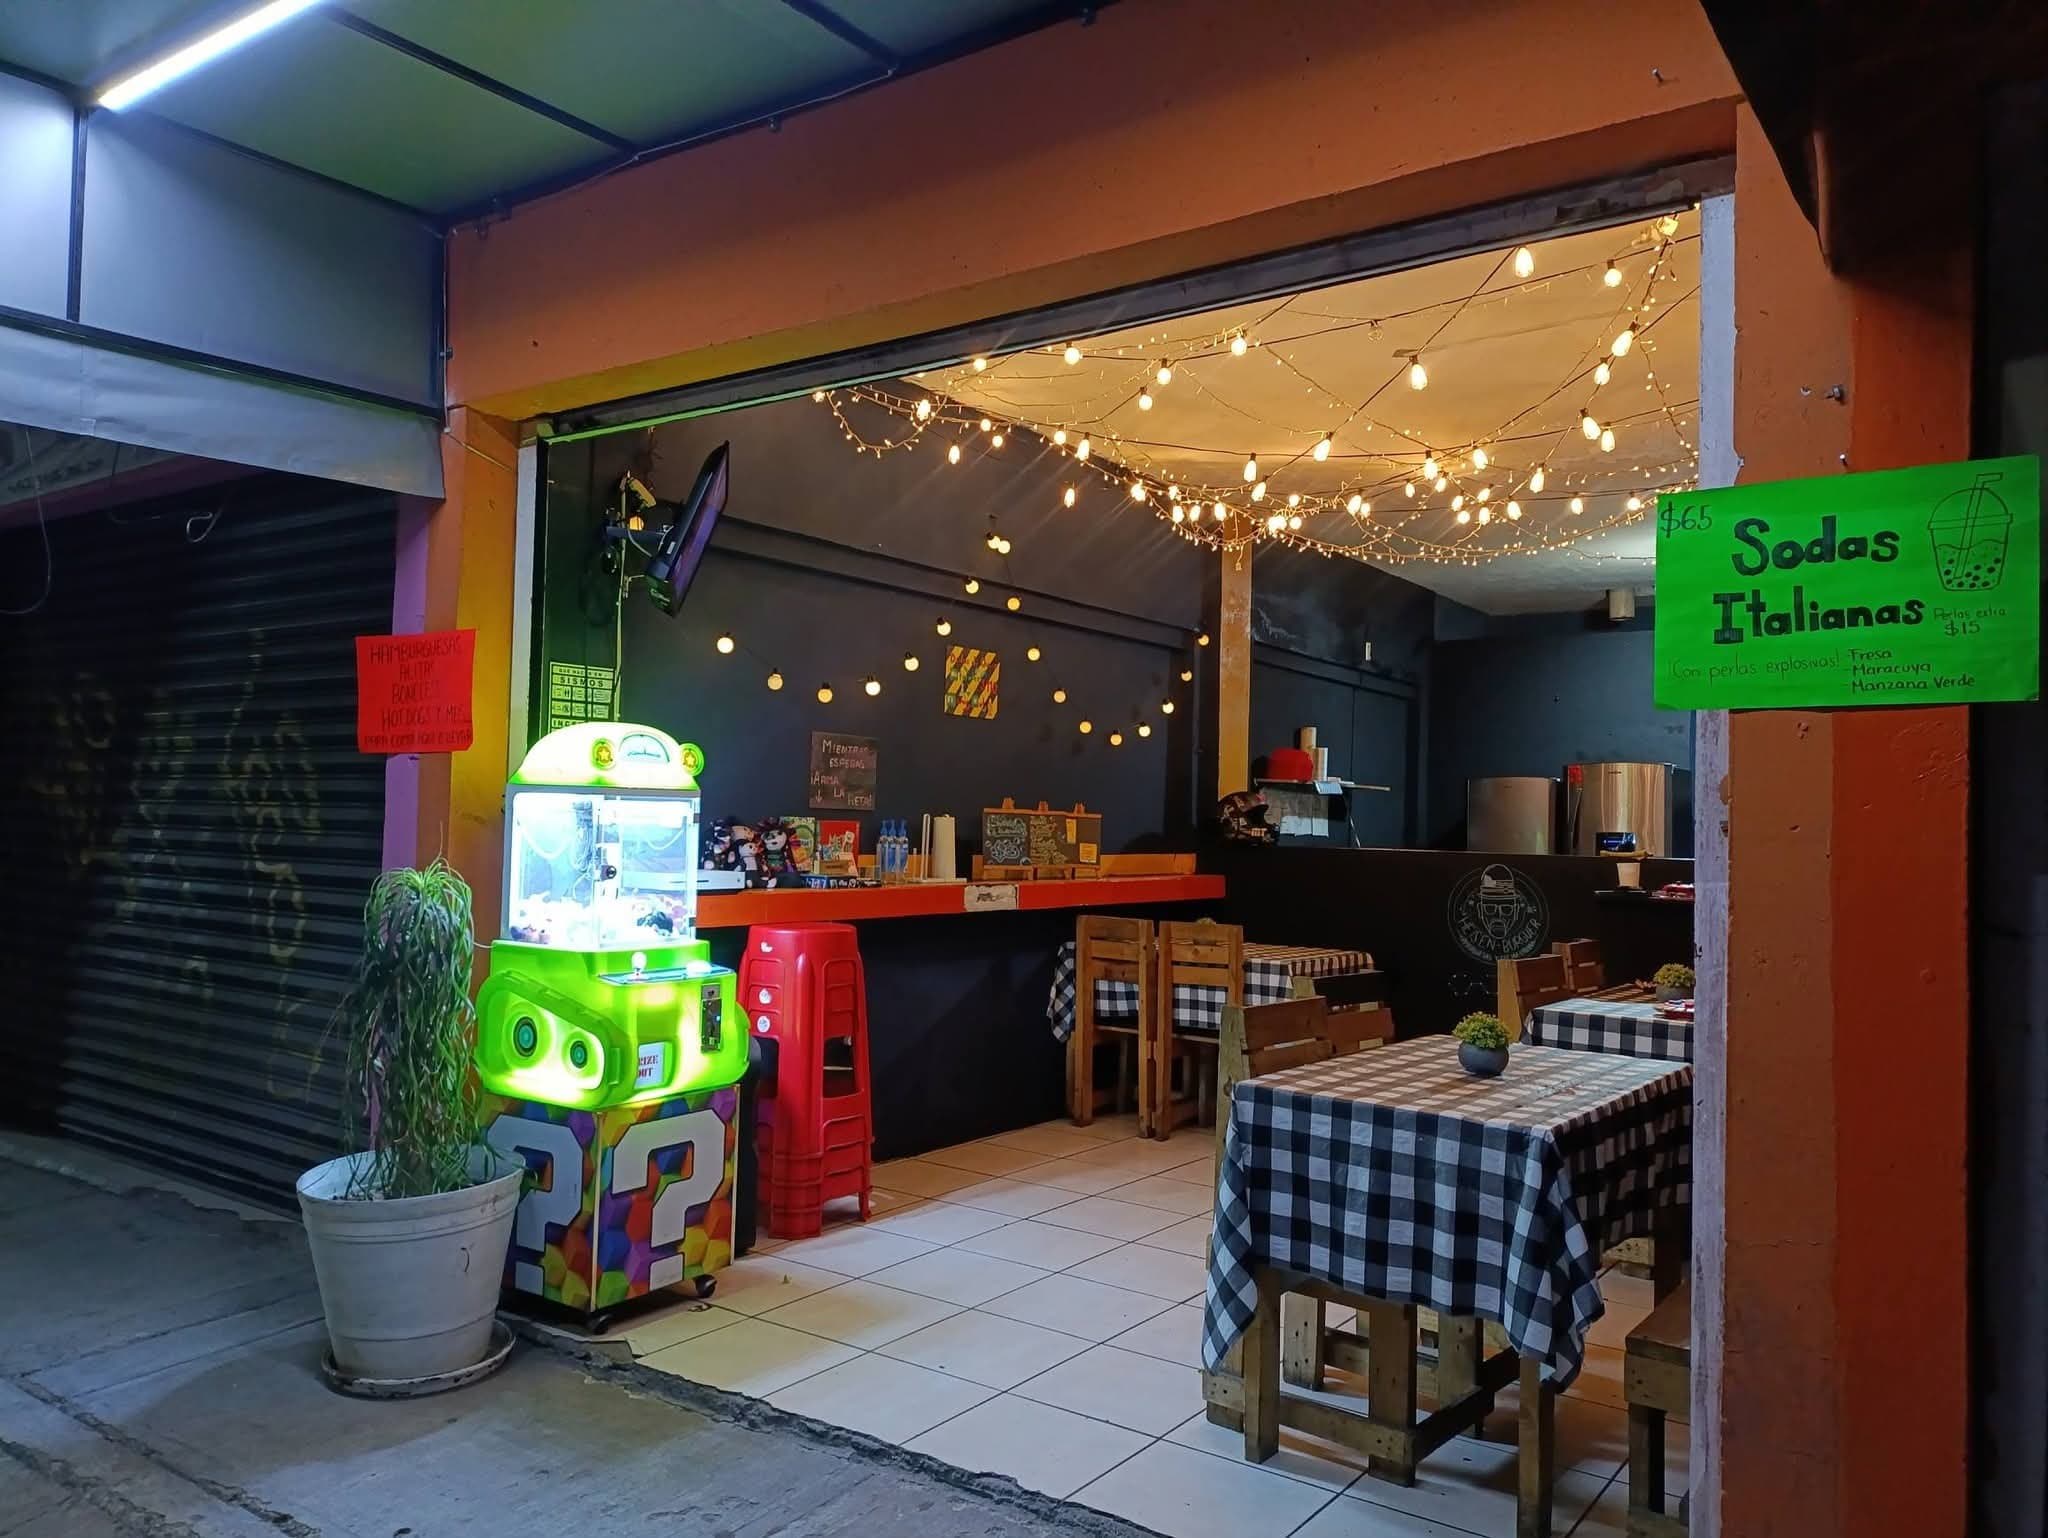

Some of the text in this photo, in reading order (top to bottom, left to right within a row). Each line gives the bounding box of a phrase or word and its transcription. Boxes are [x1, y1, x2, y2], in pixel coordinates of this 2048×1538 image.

[1660, 501, 1713, 538] $65
[1731, 515, 1900, 576] Sodas
[1713, 585, 1925, 644] Italianas
[1934, 602, 2007, 621] Perlas extra
[1944, 619, 1981, 637] $15
[1848, 648, 1892, 661] Fresa
[1709, 651, 1757, 687] perlas
[1766, 649, 1841, 681] explosivas!
[1852, 663, 1932, 677] Maracuya
[560, 677, 605, 688] SISMOS
[1852, 673, 1976, 694] Manzana Verde
[638, 1054, 659, 1066] RIZE
